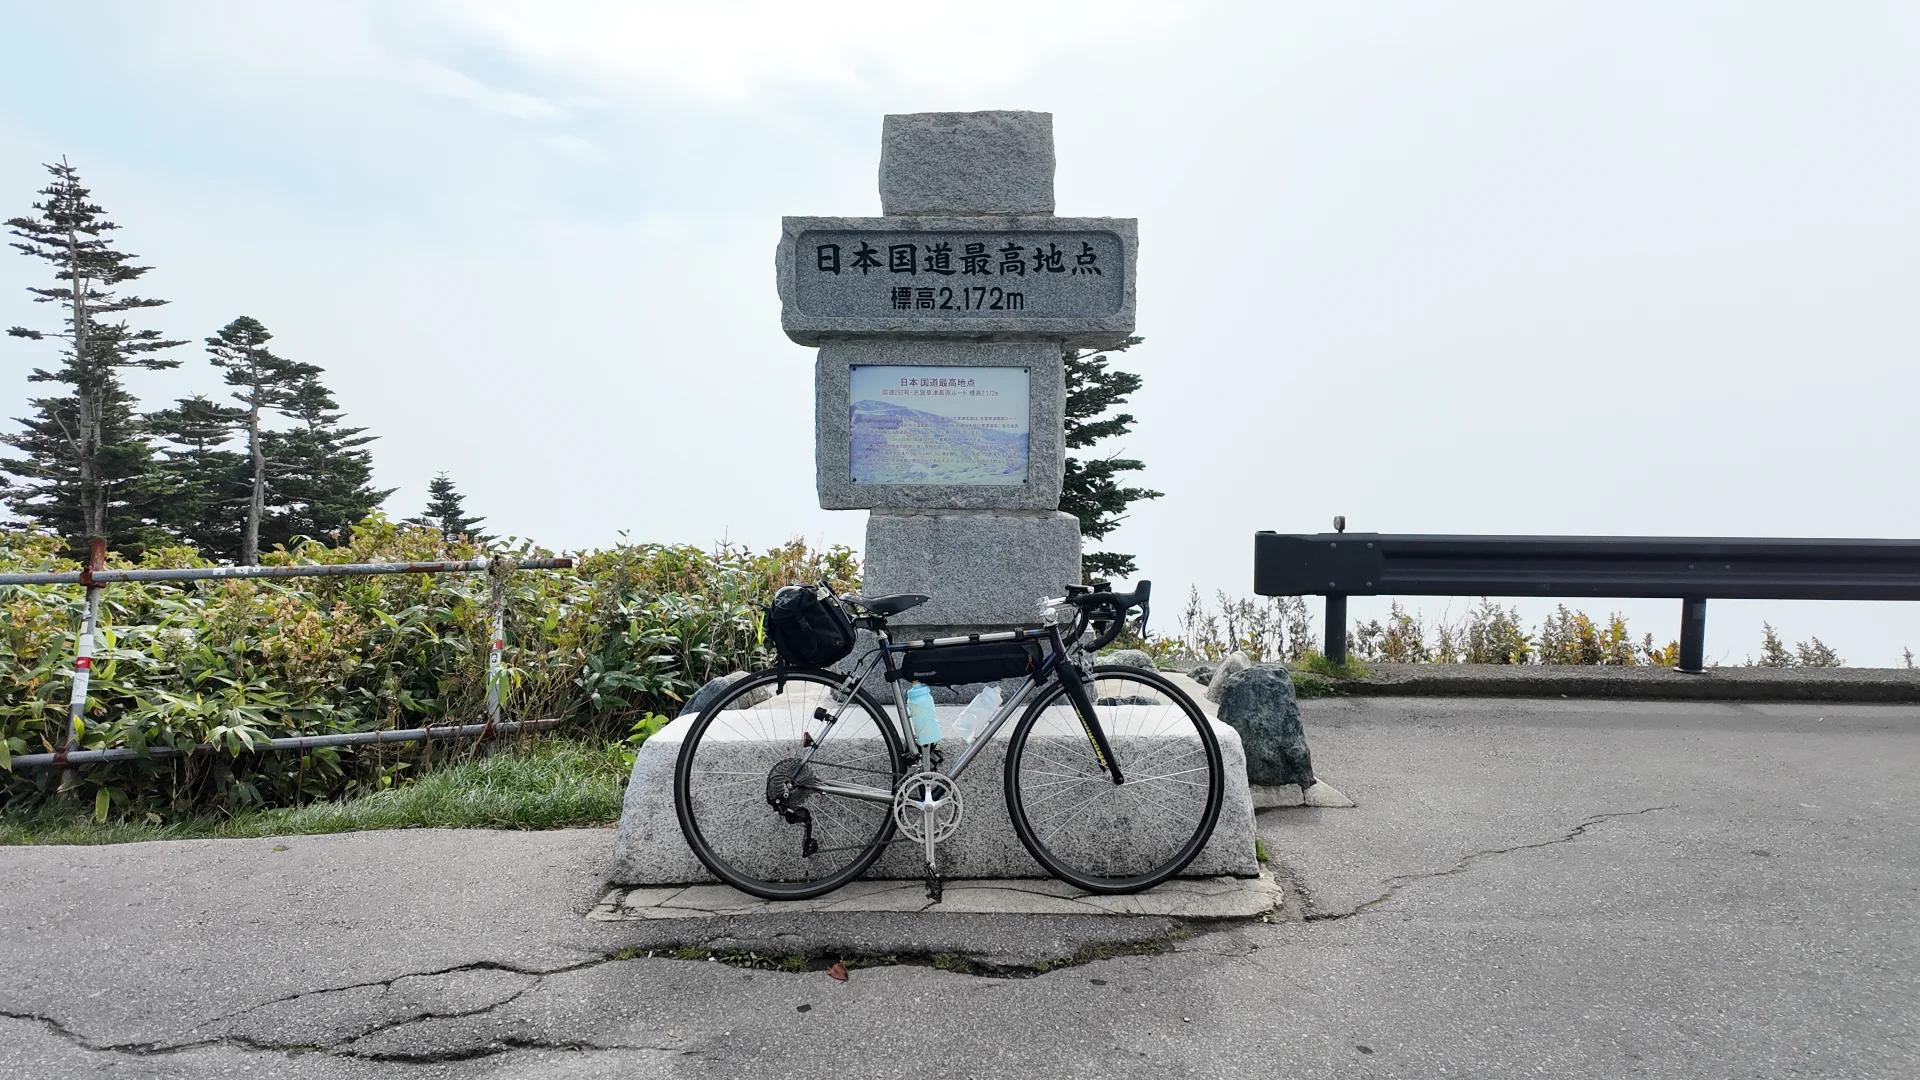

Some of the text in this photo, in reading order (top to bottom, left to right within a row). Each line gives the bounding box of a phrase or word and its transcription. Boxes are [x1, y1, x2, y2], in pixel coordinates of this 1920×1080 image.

[817, 241, 1102, 276] 日本国道最高地点
[890, 286, 1025, 311] 標高2,172m
